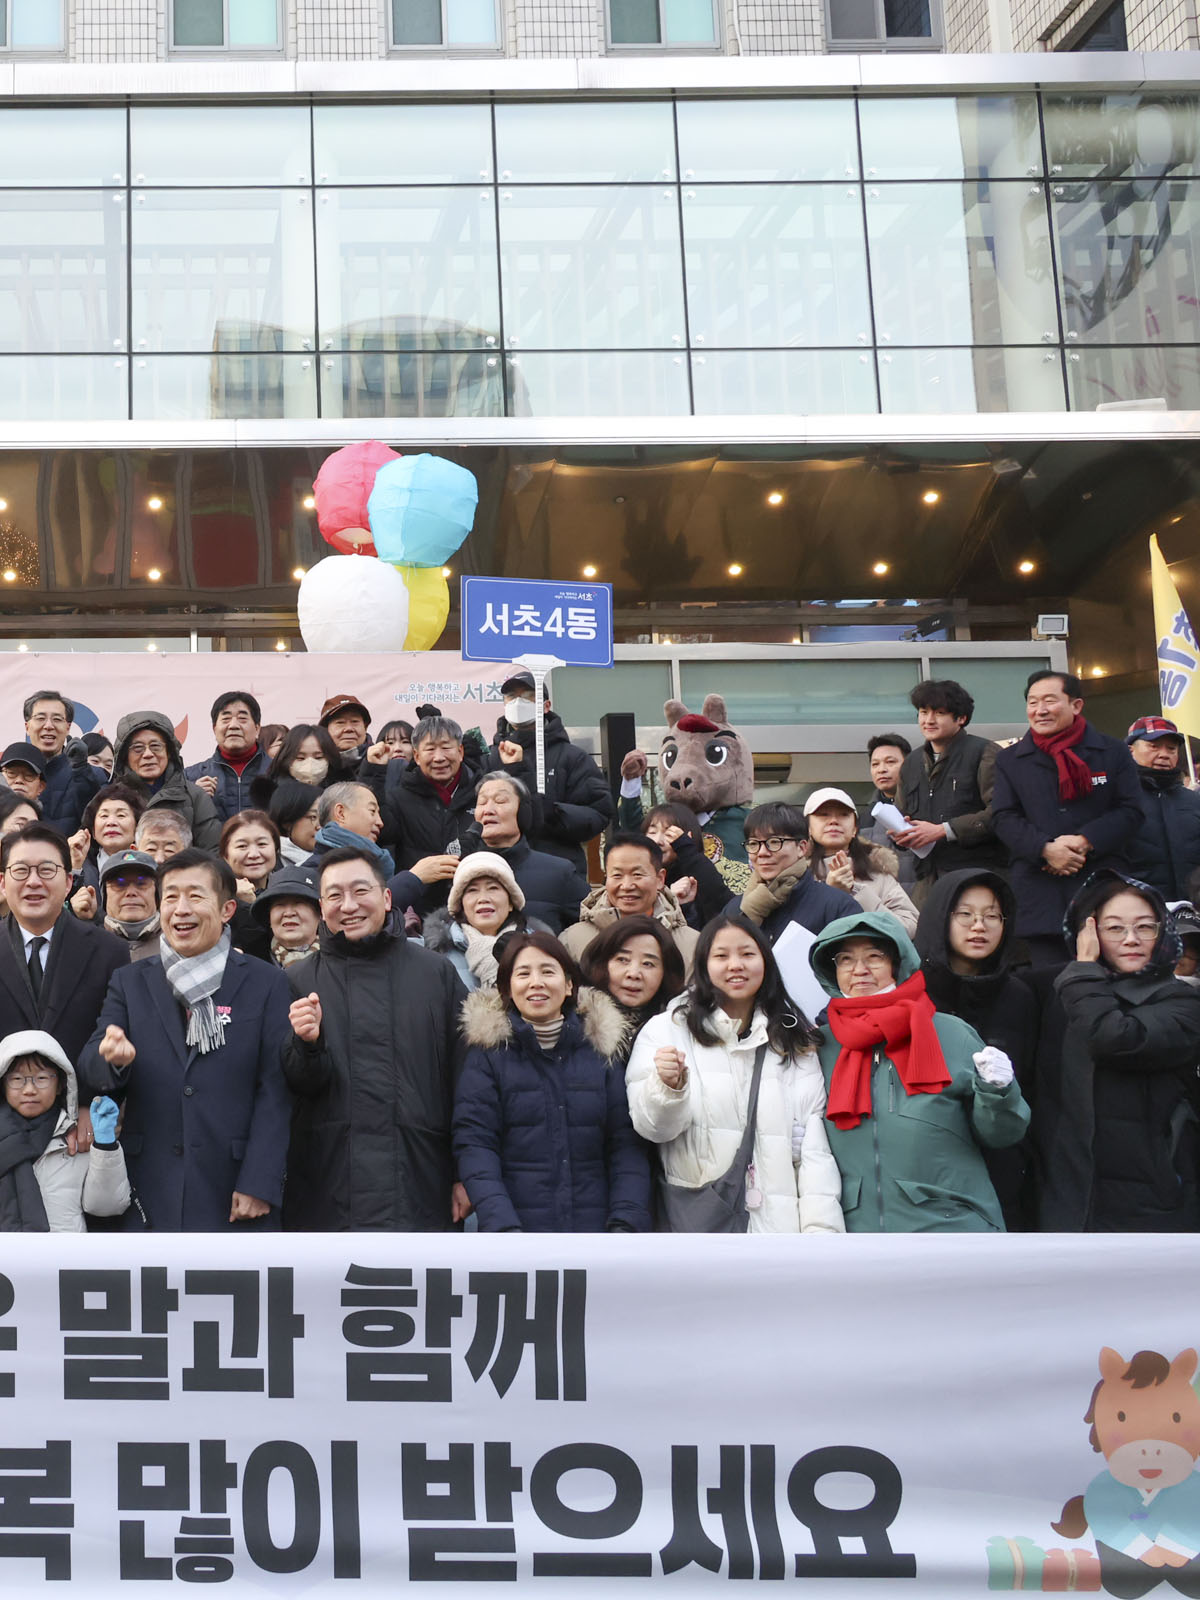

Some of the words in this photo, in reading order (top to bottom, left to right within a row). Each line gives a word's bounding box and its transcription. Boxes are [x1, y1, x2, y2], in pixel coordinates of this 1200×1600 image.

[479, 602, 598, 640] 서초4동
[463, 681, 504, 703] 서초
[58, 1266, 305, 1401] 말과
[340, 1263, 587, 1402] 함께
[117, 1439, 361, 1583] 많이
[401, 1441, 917, 1582] 받으세요
